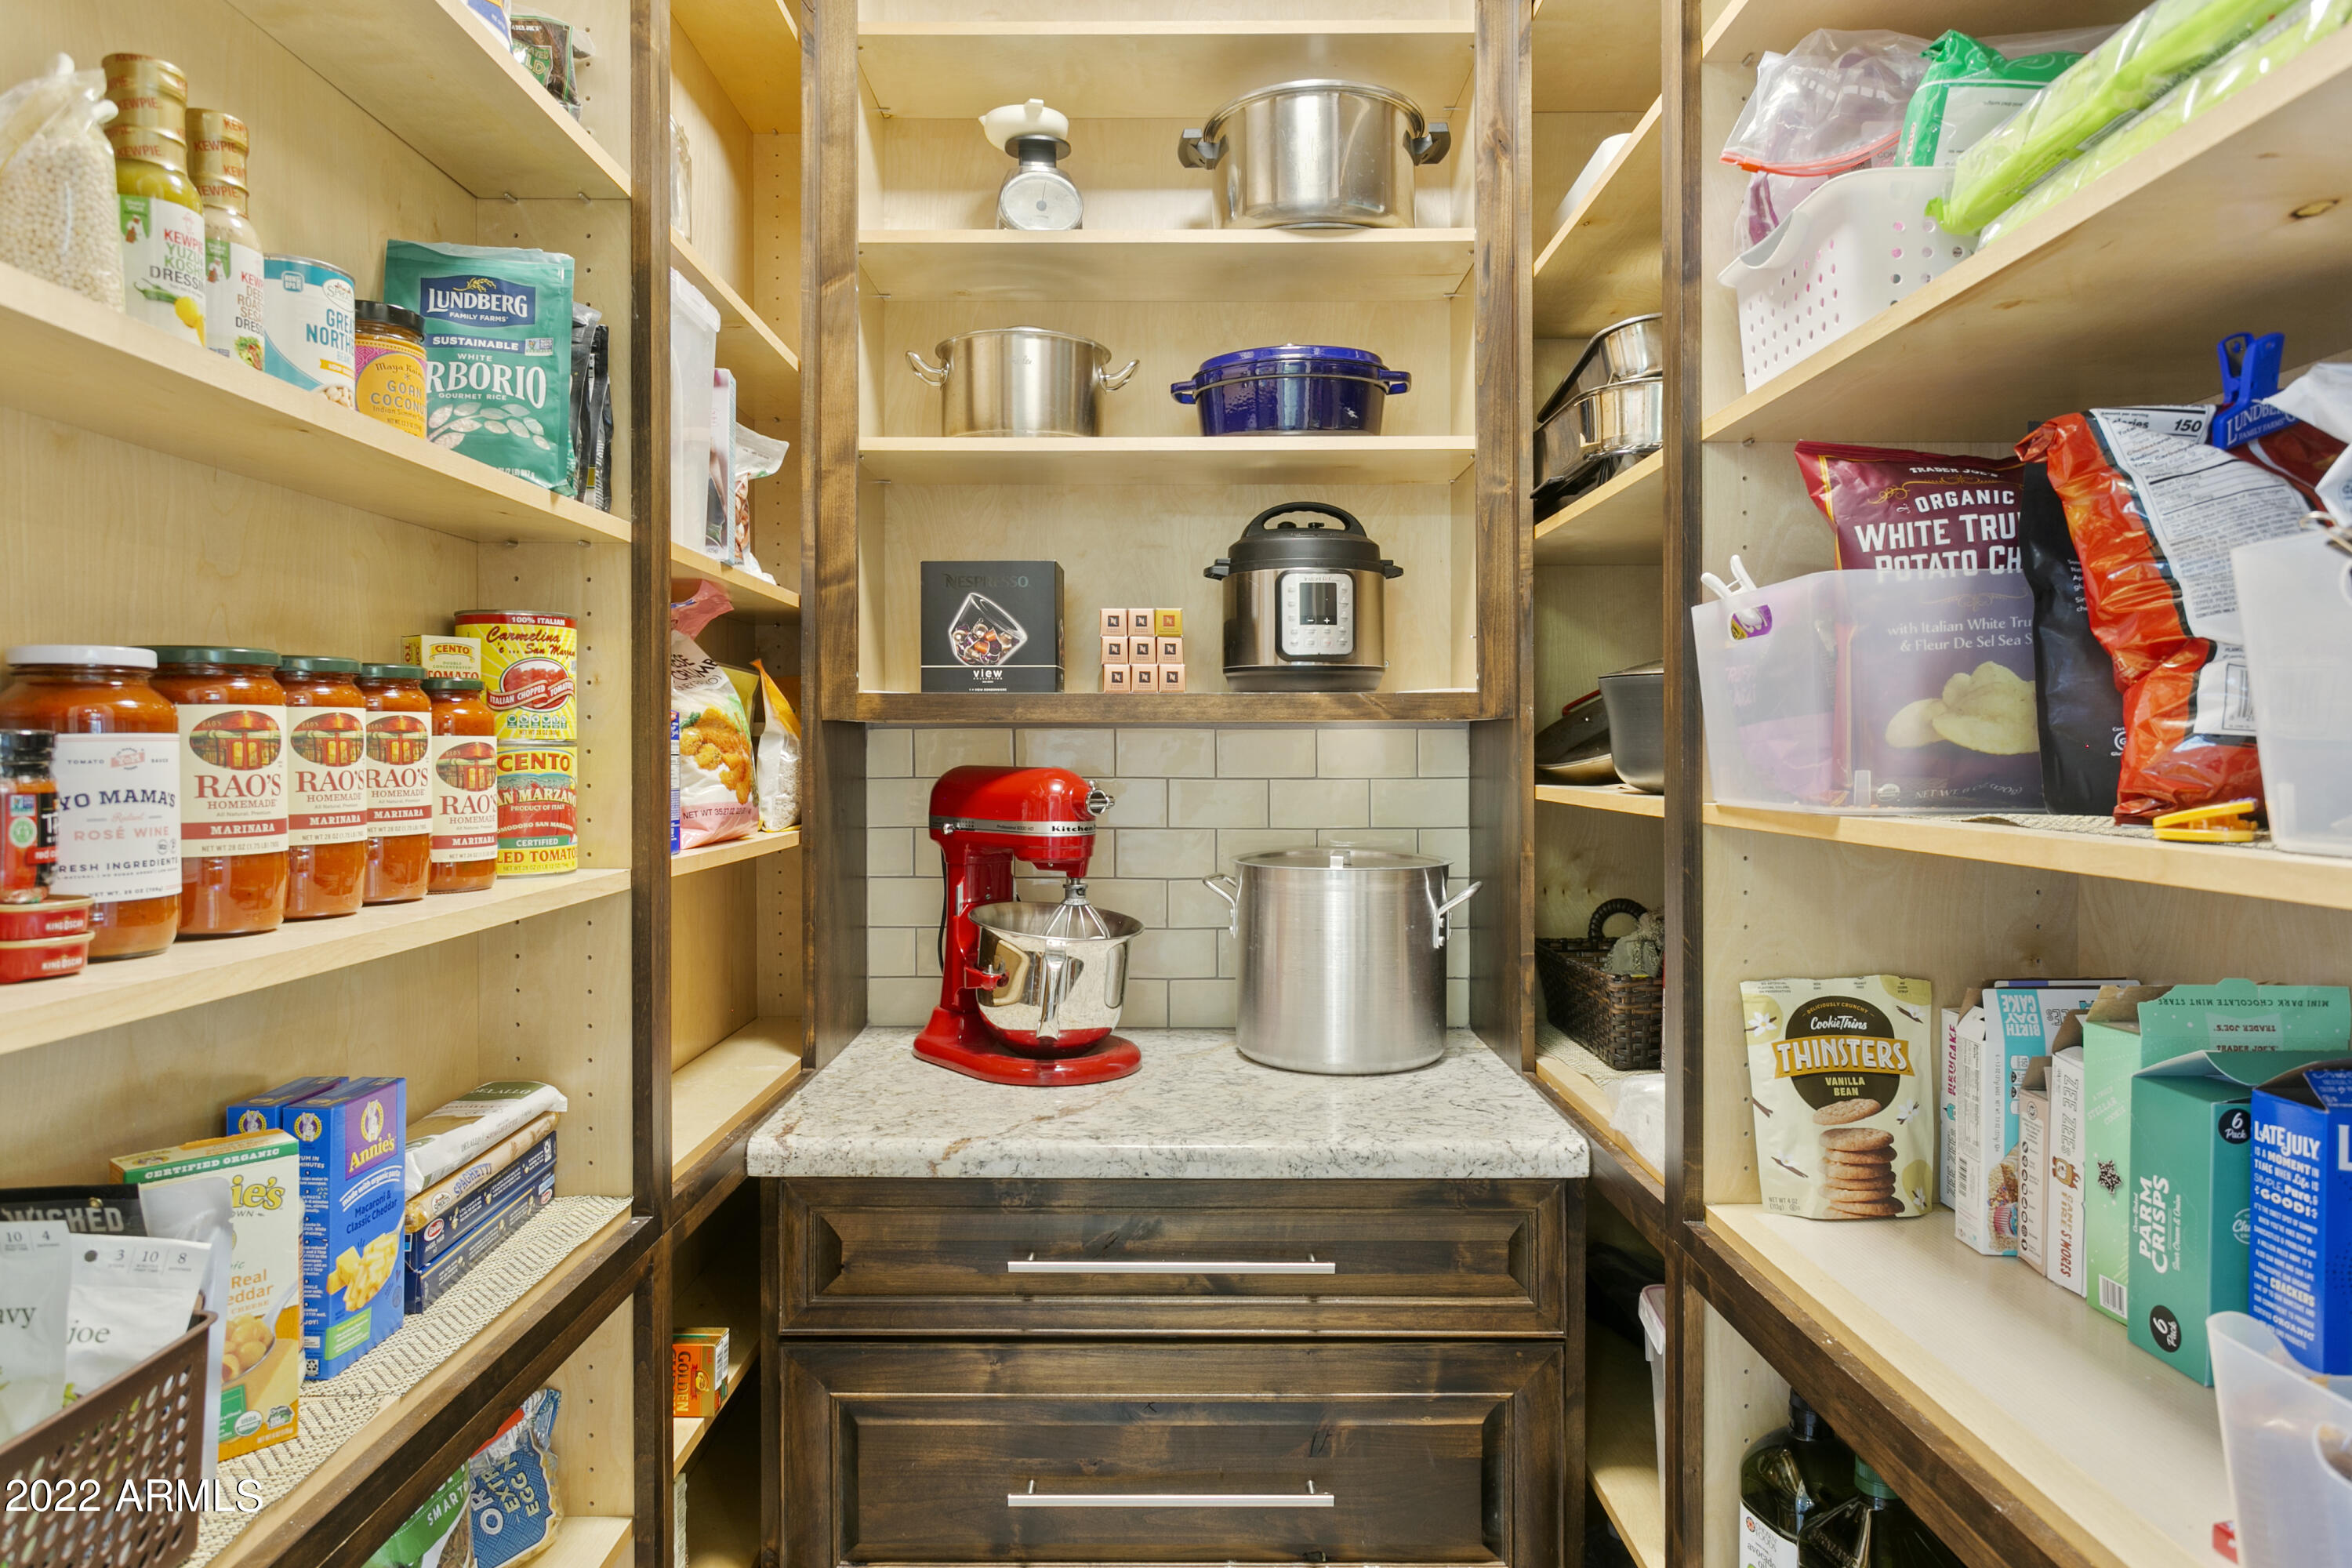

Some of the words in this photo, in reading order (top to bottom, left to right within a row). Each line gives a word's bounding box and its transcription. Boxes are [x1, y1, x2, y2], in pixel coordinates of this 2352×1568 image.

[426, 288, 528, 318] LUNDBERG
[326, 309, 355, 333] GREA
[449, 311, 477, 321] FAMILY
[480, 314, 509, 322] FARMS
[432, 336, 519, 350] SUSTAINABLE
[457, 353, 492, 362] WHITE
[375, 361, 404, 375] Maya
[387, 380, 423, 397] GOAN
[426, 361, 546, 409] RBORIO
[2173, 419, 2203, 432] 150
[2238, 426, 2261, 441] FAMILY
[2263, 418, 2285, 434] FARMS
[1915, 488, 2015, 513] ORGANIC
[1854, 518, 1951, 553] WHITE
[1875, 550, 1978, 583] POTATO
[943, 574, 1029, 589] NESPRESSO
[537, 617, 565, 626] ITALIAN
[1887, 622, 1918, 637] with
[1922, 619, 1963, 633] Italian
[1967, 618, 2005, 631] White
[485, 626, 561, 644] Carmelina
[1900, 640, 1911, 652] &
[1916, 638, 1950, 651] Fleur
[1954, 637, 1973, 649] De
[1976, 636, 1994, 648] Sel
[1998, 634, 2021, 647] Sea
[434, 644, 470, 655] CENTO
[524, 643, 545, 655] San
[427, 670, 480, 680] TOMATO
[972, 668, 1003, 678] view
[489, 693, 515, 705] ITALIAN
[517, 684, 546, 699] CHOPPED
[497, 752, 571, 772] CENTO
[194, 773, 281, 799] RAO'S
[295, 770, 365, 793] RAO'S
[367, 768, 428, 789] RAO'S
[60, 792, 91, 811] YO
[100, 789, 176, 808] MAMA'S
[307, 793, 361, 804] HOMEMADE
[372, 789, 425, 798] HOMEMADE
[517, 788, 577, 808] MARZANO
[1915, 789, 1935, 800] NET
[207, 800, 277, 810] HOMEMADE
[374, 809, 424, 819] MARINARA
[683, 811, 699, 820] NET
[701, 808, 713, 817] WT
[210, 823, 275, 836] MARINARA
[309, 815, 361, 826] MARINARA
[449, 815, 495, 825] HOMEMADE
[74, 825, 125, 842] ROSÉ
[133, 825, 170, 839] WINE
[452, 836, 495, 846] MARINARA
[516, 838, 559, 847] CERTIFIED
[1806, 1002, 1840, 1014] DELICIOUSLY
[1841, 1002, 1869, 1014] CRUNCHY
[2000, 994, 2038, 1013] CAKE
[2217, 999, 2274, 1007] CHOCOLATE
[2005, 1012, 2038, 1024] DAY
[2006, 1023, 2042, 1036] BIRTH
[1777, 1038, 1908, 1073] THINSTERS
[1824, 1076, 1865, 1087] VANILLA
[1833, 1087, 1859, 1097] BEAN
[2062, 1074, 2078, 1112] ZEE
[2087, 1098, 2118, 1120] STELLAR
[2231, 1112, 2244, 1129] 6
[2060, 1113, 2078, 1156] ZEES
[2224, 1127, 2247, 1139] Pack
[347, 1134, 395, 1174] Annie's
[2254, 1146, 2261, 1156] IS
[2262, 1149, 2267, 1159] A
[2267, 1151, 2311, 1176] MOMENT
[2312, 1167, 2320, 1179] IN
[144, 1159, 220, 1180] CERTIFIED
[223, 1148, 280, 1165] ORGANIC
[453, 1163, 493, 1198] SPAGHETTI
[2254, 1159, 2274, 1174] TIME
[2274, 1166, 2292, 1181] WHEN
[2292, 1174, 2310, 1190] Life
[2311, 1181, 2319, 1192] IS
[342, 1189, 358, 1208] made
[358, 1181, 371, 1196] with
[370, 1173, 390, 1187] organic
[2284, 1184, 2313, 1204] Pure,
[354, 1197, 387, 1218] Macaroni
[386, 1190, 392, 1200] &
[346, 1213, 371, 1234] Classic
[372, 1199, 397, 1221] Cheddar
[2139, 1176, 2153, 1259] PARM
[2152, 1174, 2170, 1274] CRISPS
[6, 1232, 22, 1243] 10
[42, 1230, 50, 1241] 4
[115, 1249, 125, 1261] 3
[142, 1250, 159, 1263] 10
[177, 1252, 188, 1264] 8
[2060, 1230, 2072, 1278] S'MORES
[230, 1269, 267, 1289] Real
[2270, 1277, 2315, 1308] CRACKERS
[67, 1319, 111, 1345] joe
[2153, 1316, 2169, 1335] 6
[2166, 1320, 2178, 1348] Pack
[2273, 1315, 2315, 1341] ORGANIC
[677, 1351, 691, 1412] GOLDEN
